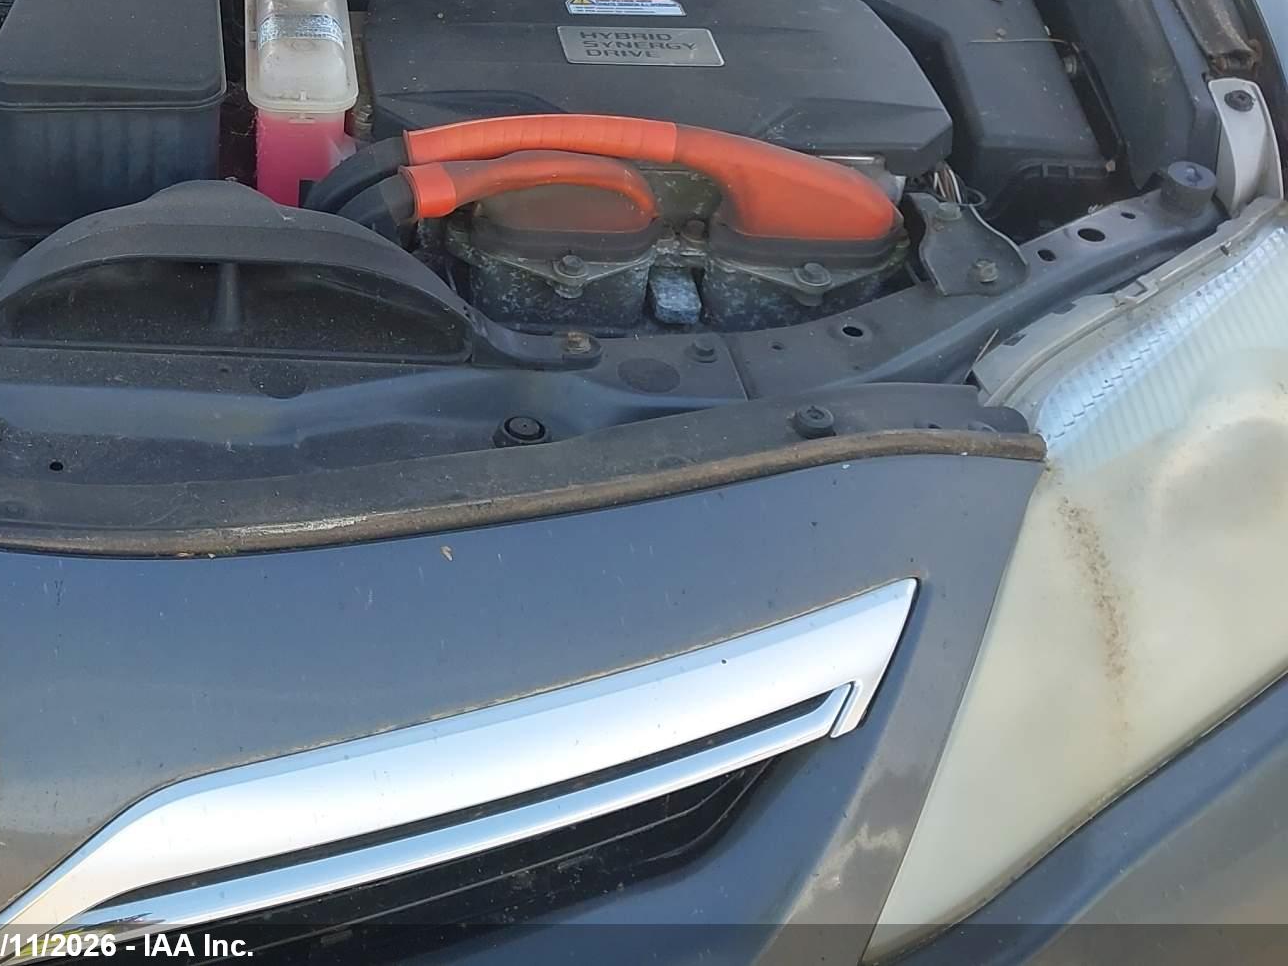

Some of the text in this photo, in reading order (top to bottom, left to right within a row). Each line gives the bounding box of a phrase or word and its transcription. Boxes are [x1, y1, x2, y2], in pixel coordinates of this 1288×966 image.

[580, 32, 673, 41] HYBRID
[582, 41, 697, 51] SYNERGY
[586, 50, 661, 59] DRIVE
